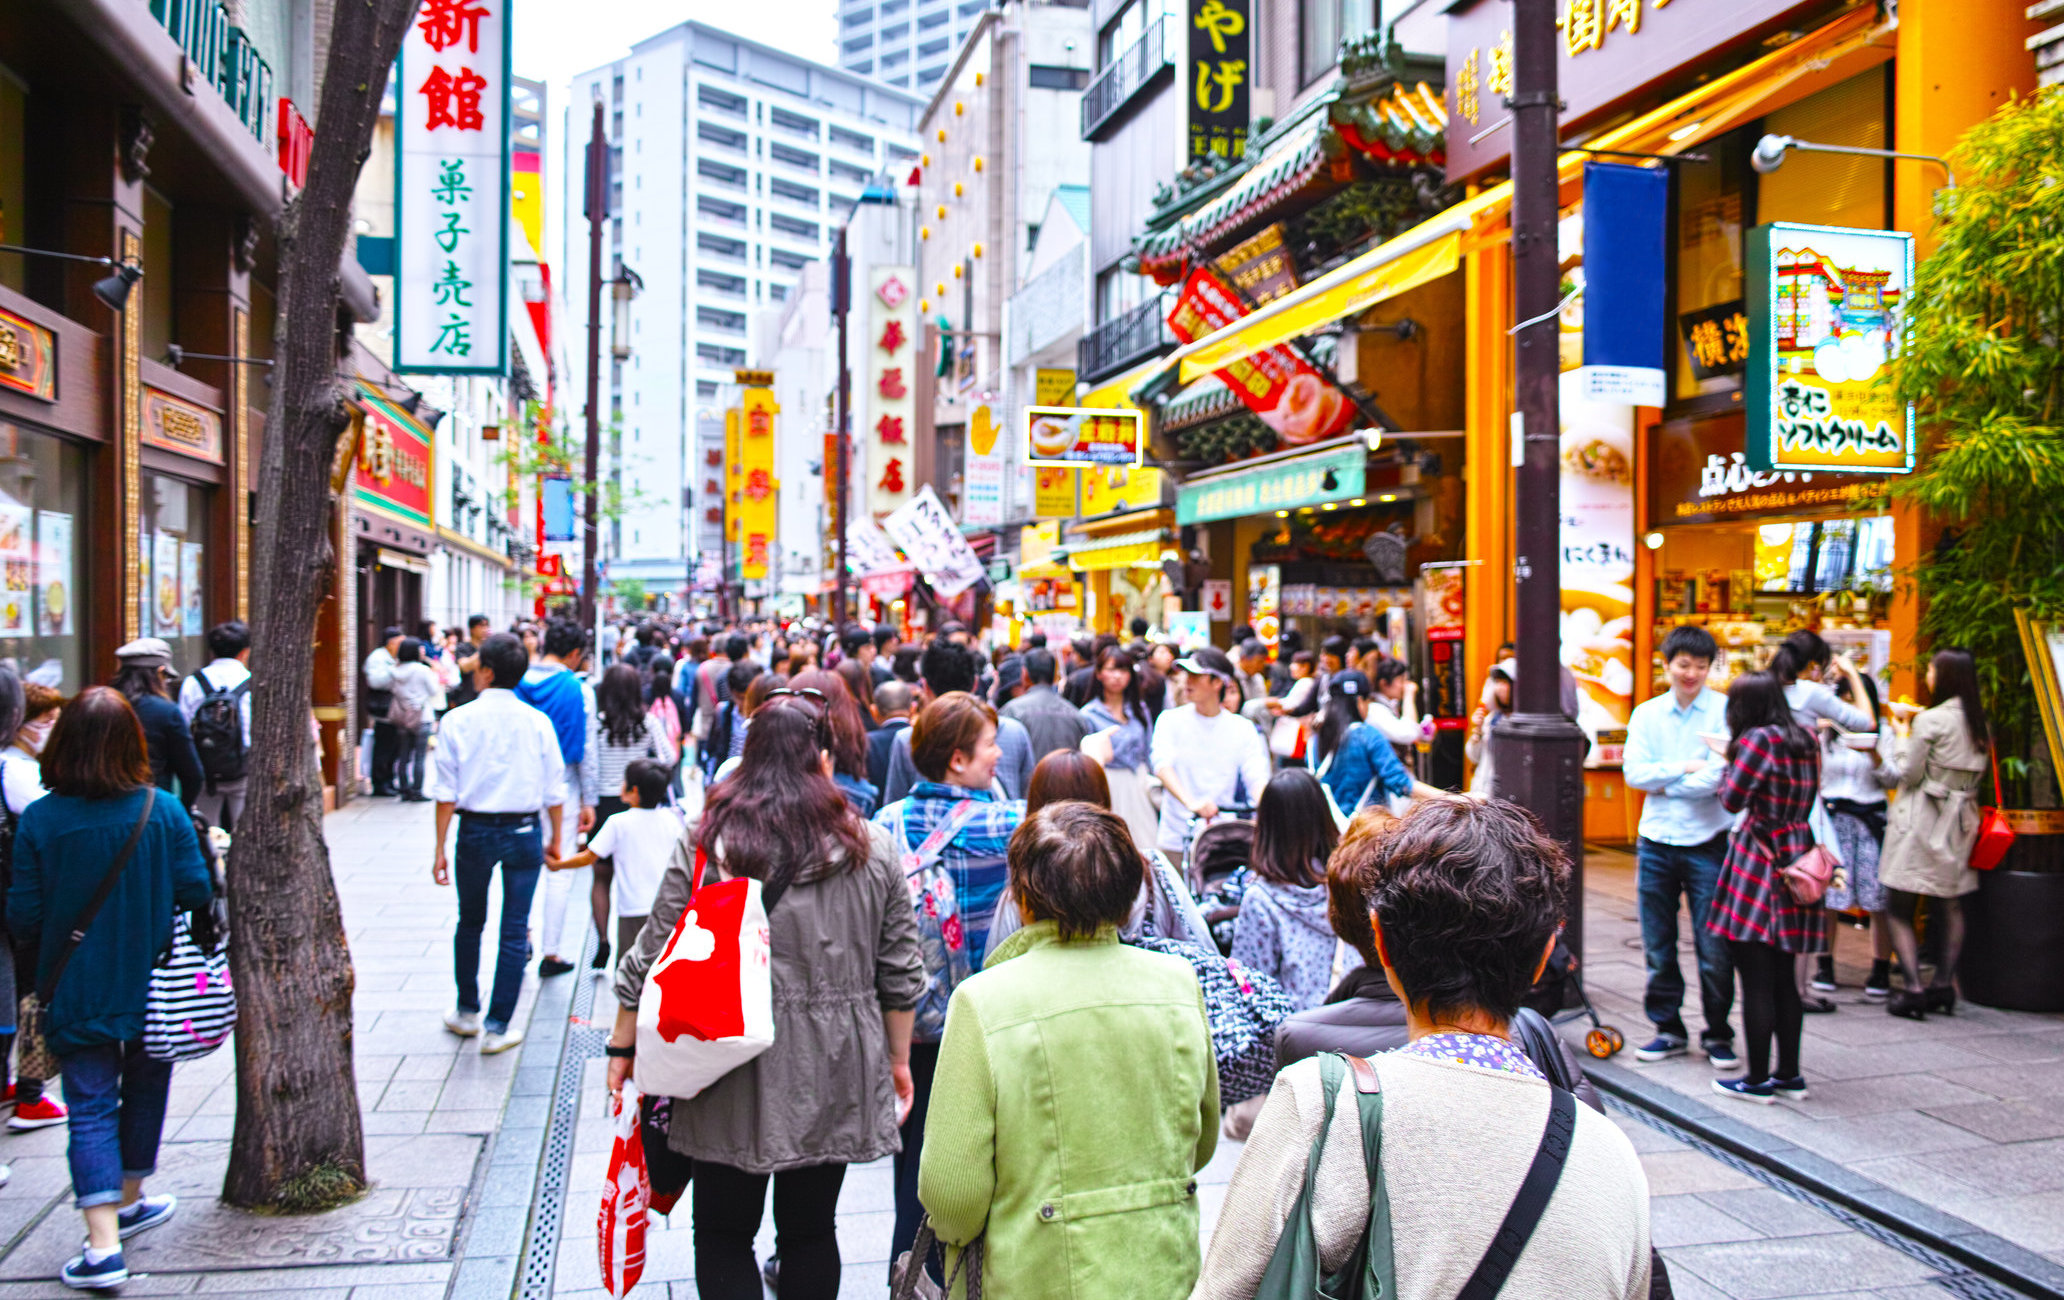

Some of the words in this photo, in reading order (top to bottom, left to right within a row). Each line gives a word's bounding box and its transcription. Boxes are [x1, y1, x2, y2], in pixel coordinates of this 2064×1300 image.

[418, 0, 491, 132] 新館
[429, 158, 474, 356] 菓子売店
[1779, 421, 1898, 451] ソフトクリーム
[1564, 542, 1631, 565] にくまん
